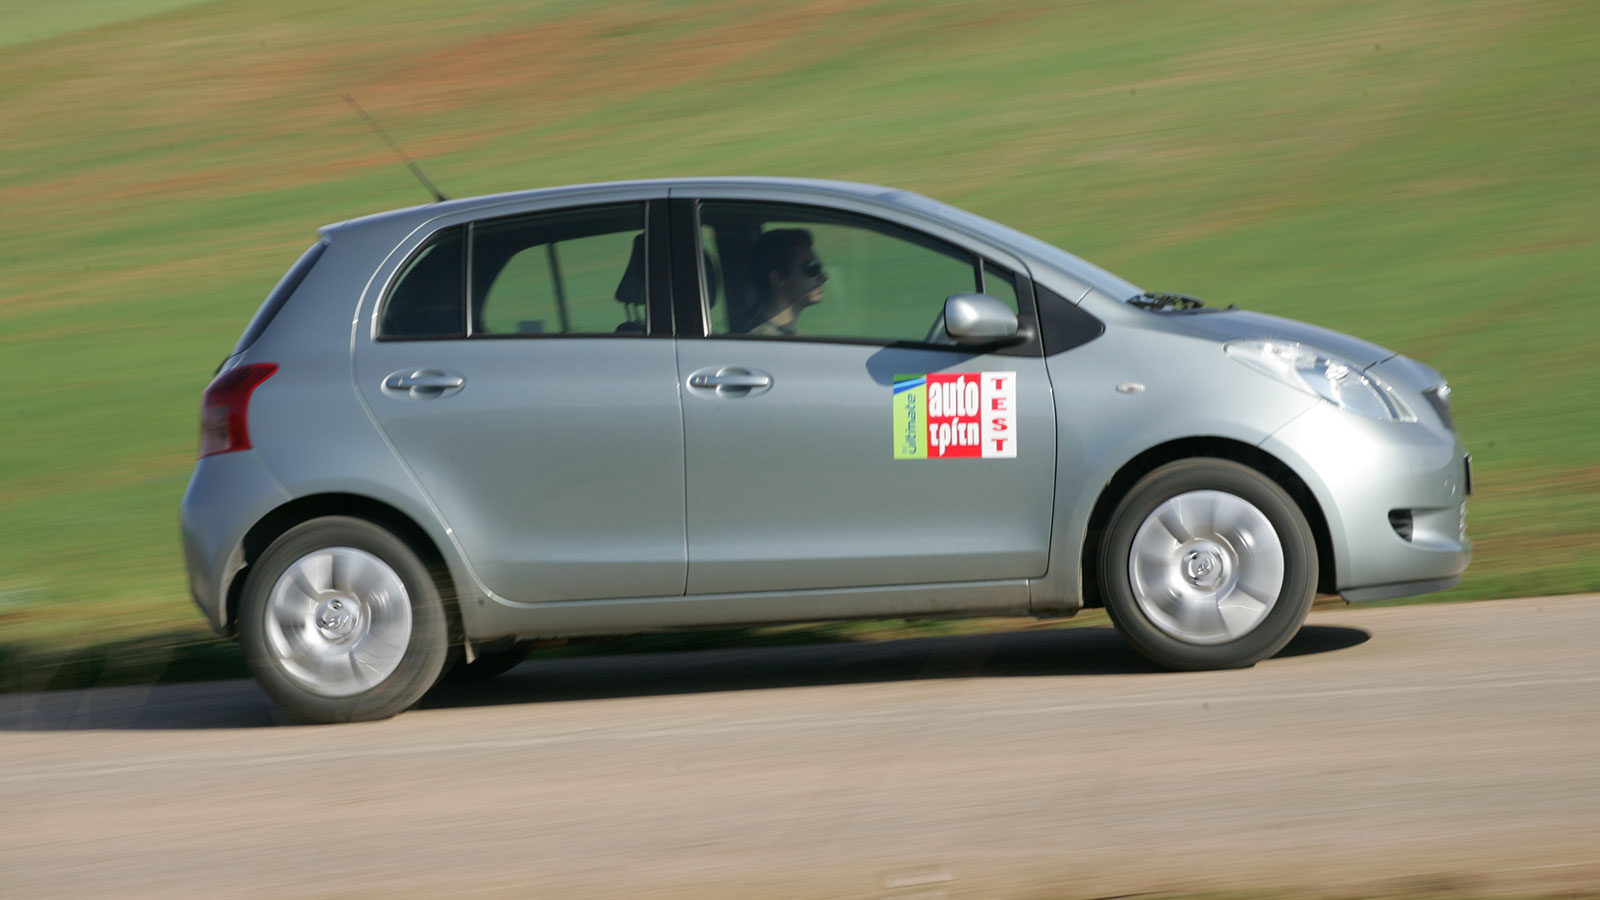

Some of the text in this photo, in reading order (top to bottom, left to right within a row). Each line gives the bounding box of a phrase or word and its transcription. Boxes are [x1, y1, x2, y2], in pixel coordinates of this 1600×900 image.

[905, 393, 917, 455] ultimate
[928, 375, 979, 417] auto
[990, 377, 1008, 452] TEST
